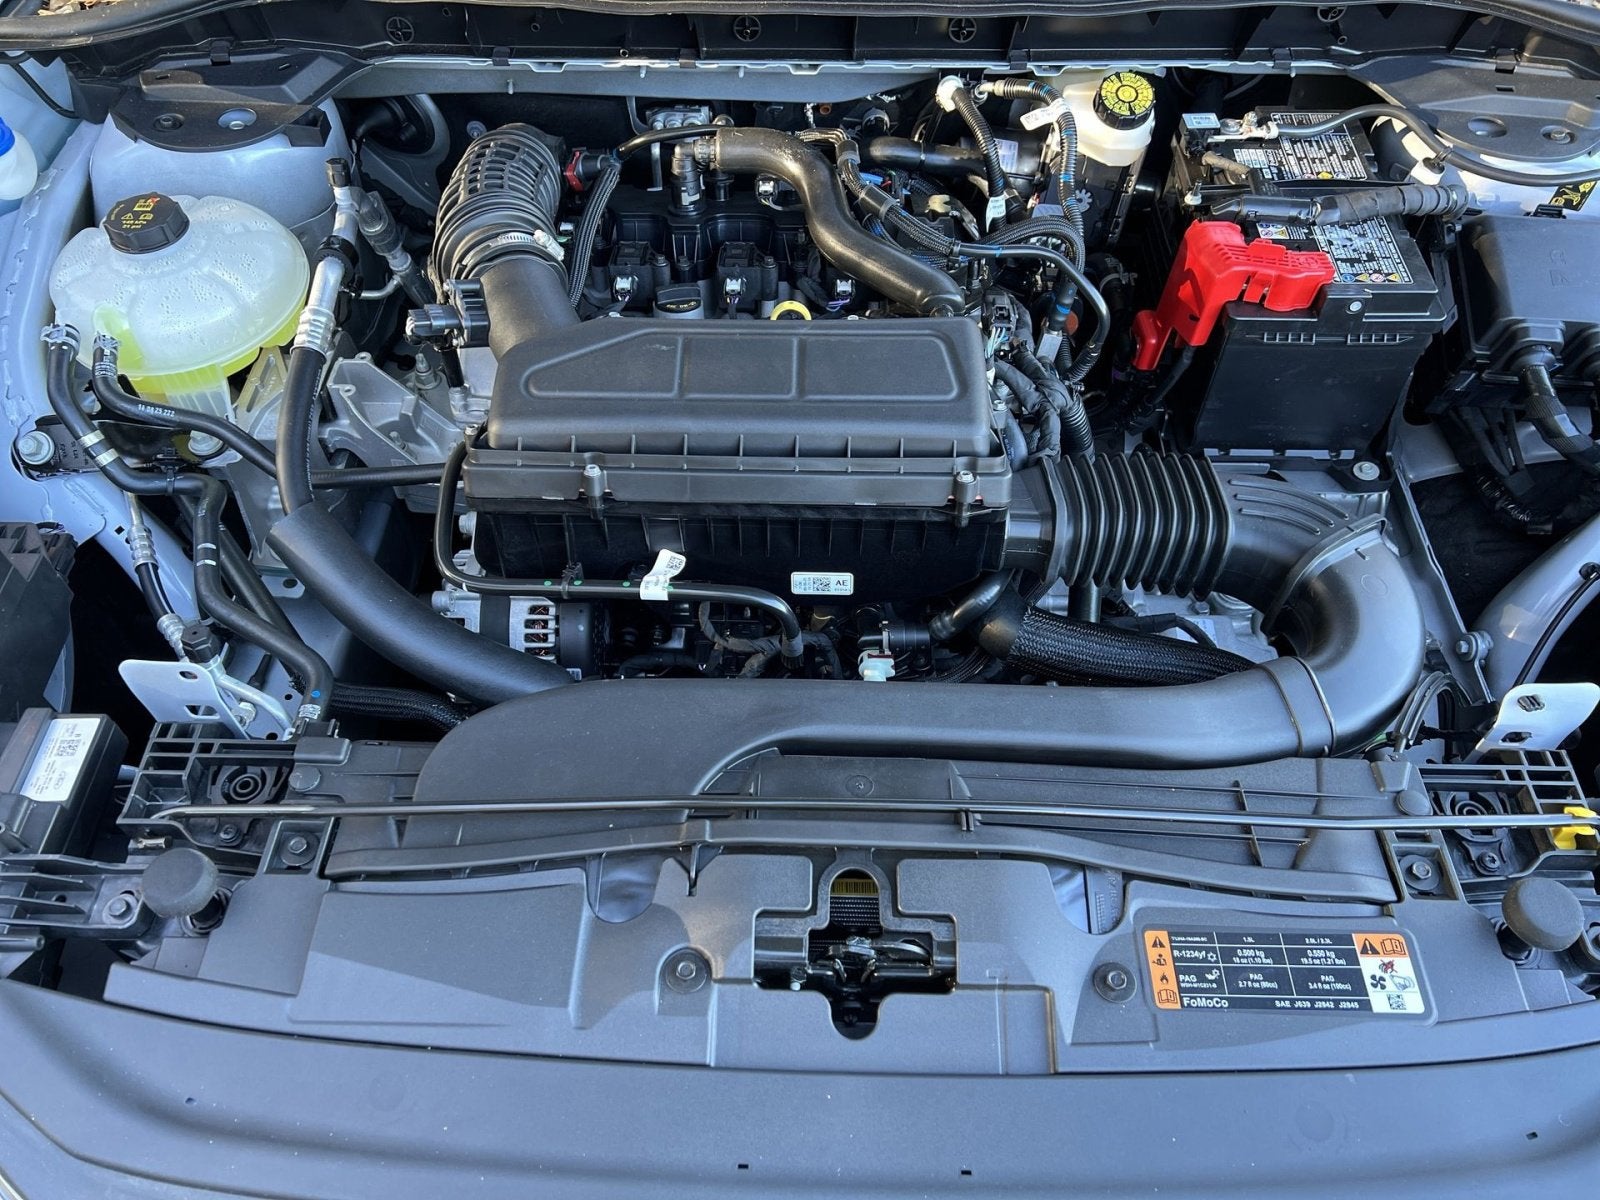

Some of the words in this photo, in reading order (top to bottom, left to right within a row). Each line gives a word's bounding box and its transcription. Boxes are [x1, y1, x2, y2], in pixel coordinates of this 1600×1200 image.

[1255, 949, 1265, 958] kg
[1326, 950, 1335, 958] kg
[1183, 998, 1229, 1007] FoMoCo
